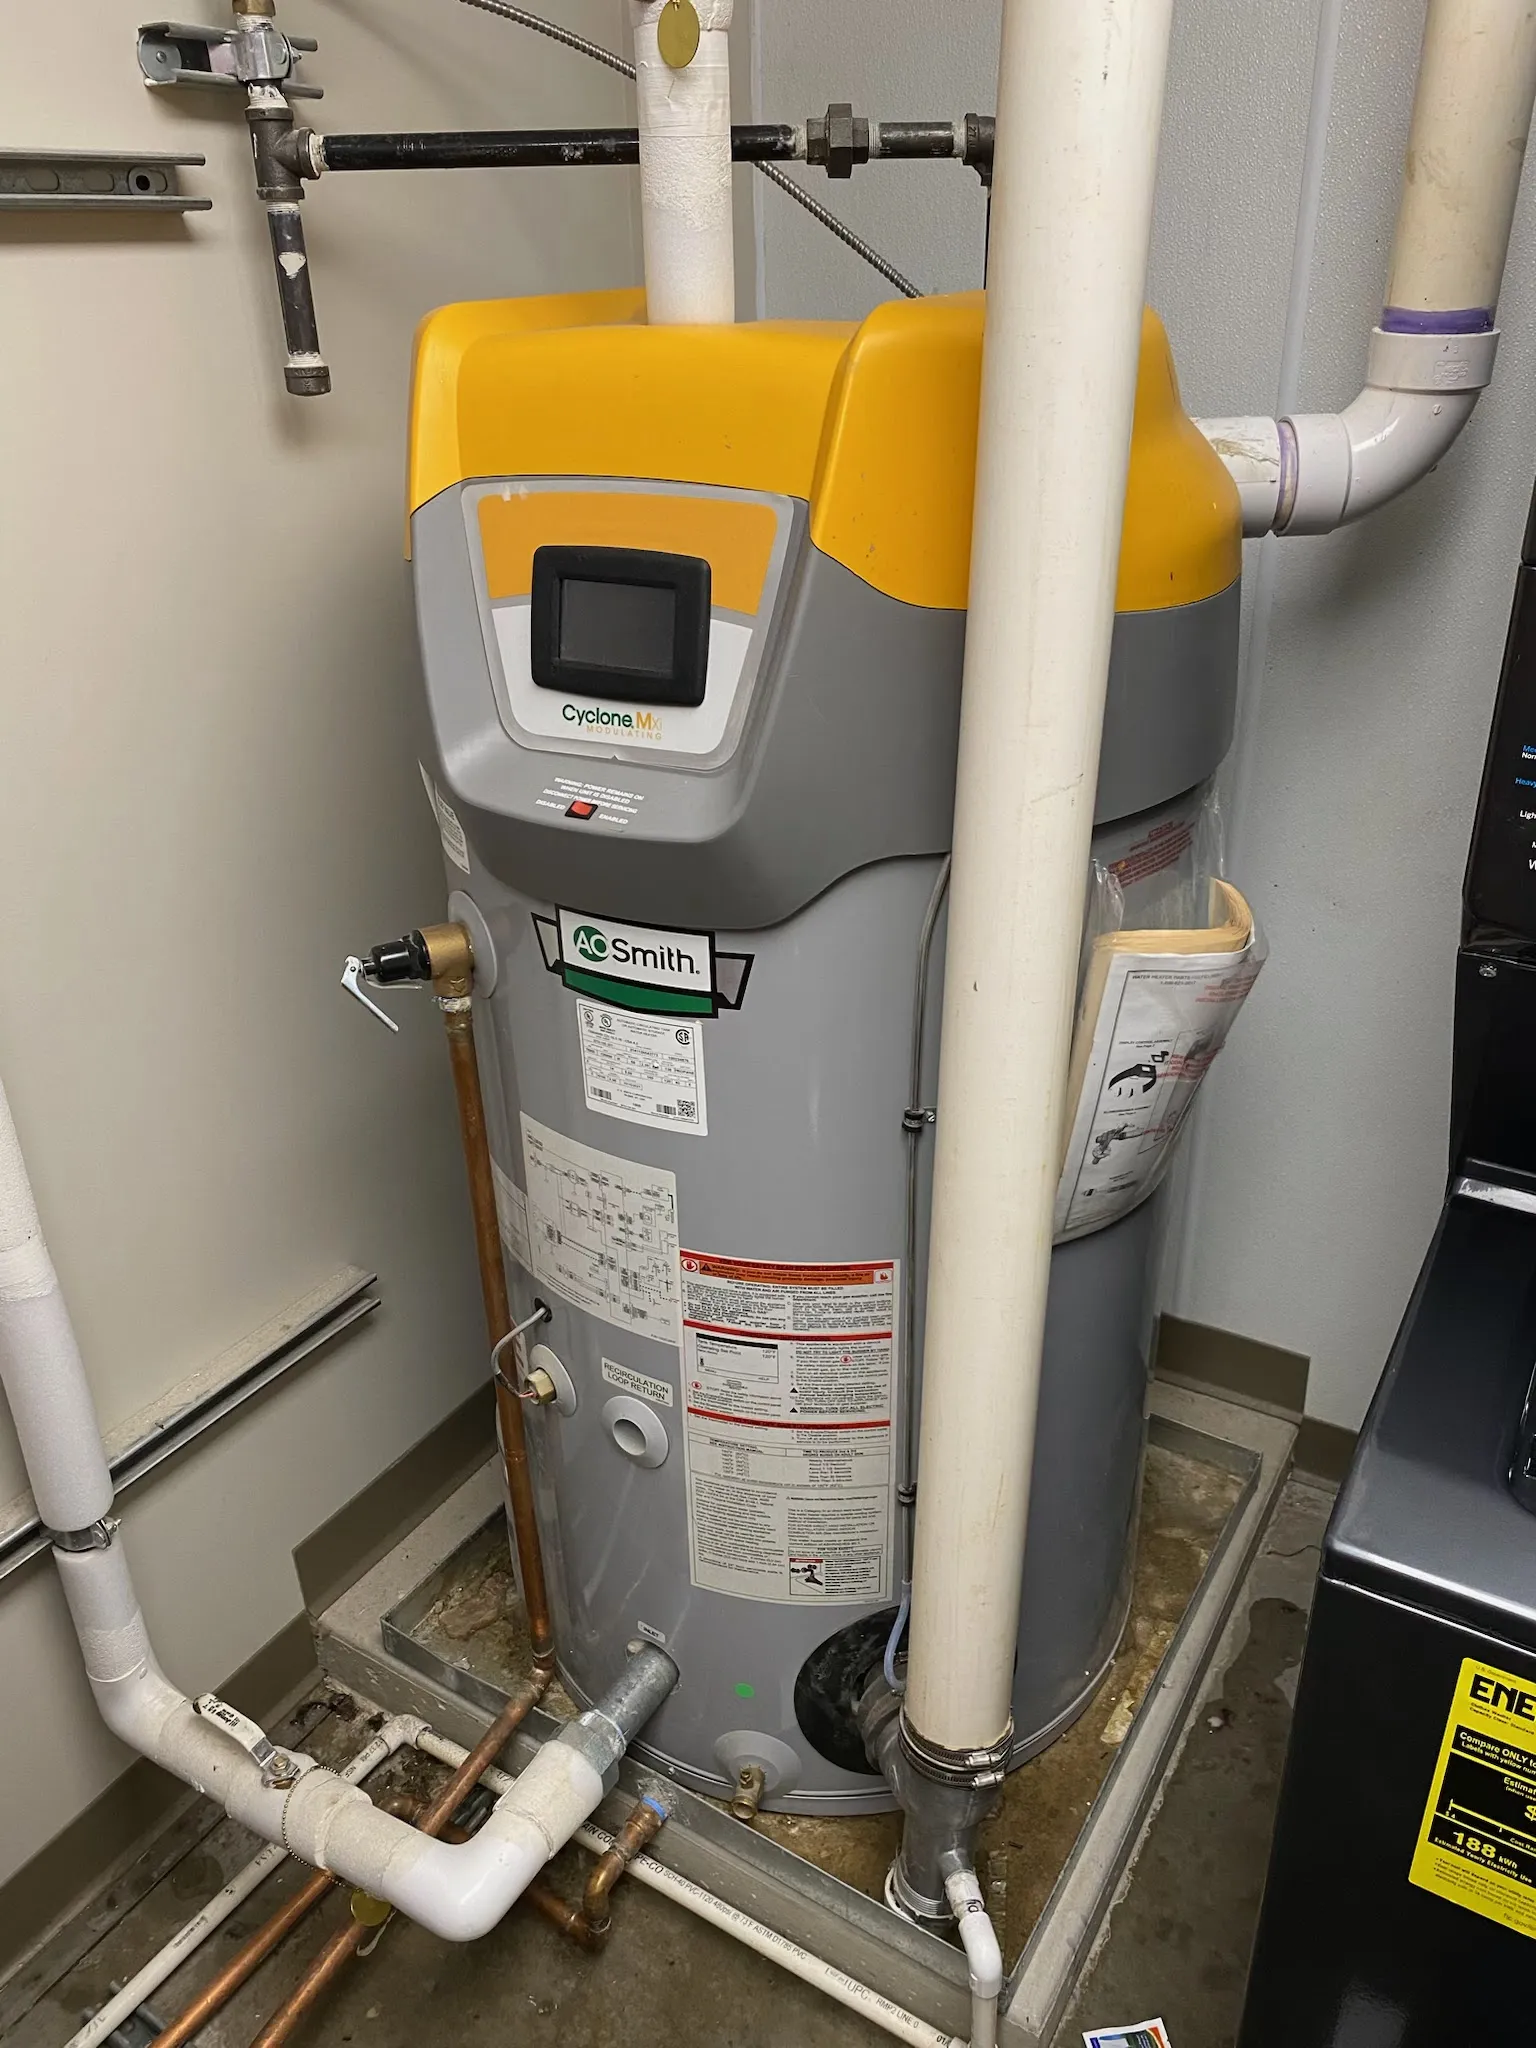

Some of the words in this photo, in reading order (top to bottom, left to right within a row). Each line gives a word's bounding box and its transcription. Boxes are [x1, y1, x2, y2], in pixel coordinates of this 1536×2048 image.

[586, 725, 662, 740] MODULATING
[560, 785, 579, 794] WHEN
[579, 789, 593, 797] UNIT
[600, 794, 631, 805] DISABLED
[584, 783, 607, 793] POWER
[535, 799, 566, 810] DISABLED
[598, 813, 629, 825] ENABLED
[604, 1362, 669, 1394] RECIRCULATION
[607, 1371, 629, 1385] LOOP
[630, 1382, 665, 1400] RETURN
[1469, 1673, 1536, 1722] ENE
[1460, 1731, 1500, 1753] Compare
[1502, 1748, 1529, 1764] ONLY
[1461, 1741, 1484, 1755] Labels
[1484, 1750, 1500, 1760] with
[1499, 1757, 1522, 1770] yellow
[597, 1830, 614, 1846] CO
[1453, 1831, 1497, 1858] 188
[1498, 1855, 1518, 1869] kWh
[1434, 1837, 1465, 1854] Estimated
[1466, 1850, 1486, 1864] Yearly
[1487, 1859, 1519, 1878] Electricity
[1519, 1872, 1533, 1883] Use
[753, 1924, 773, 1939] ASTM
[772, 1935, 792, 1951] D1785
[791, 1947, 808, 1960] PVC
[875, 1998, 897, 2015] RMP2
[896, 2009, 913, 2026] LINE
